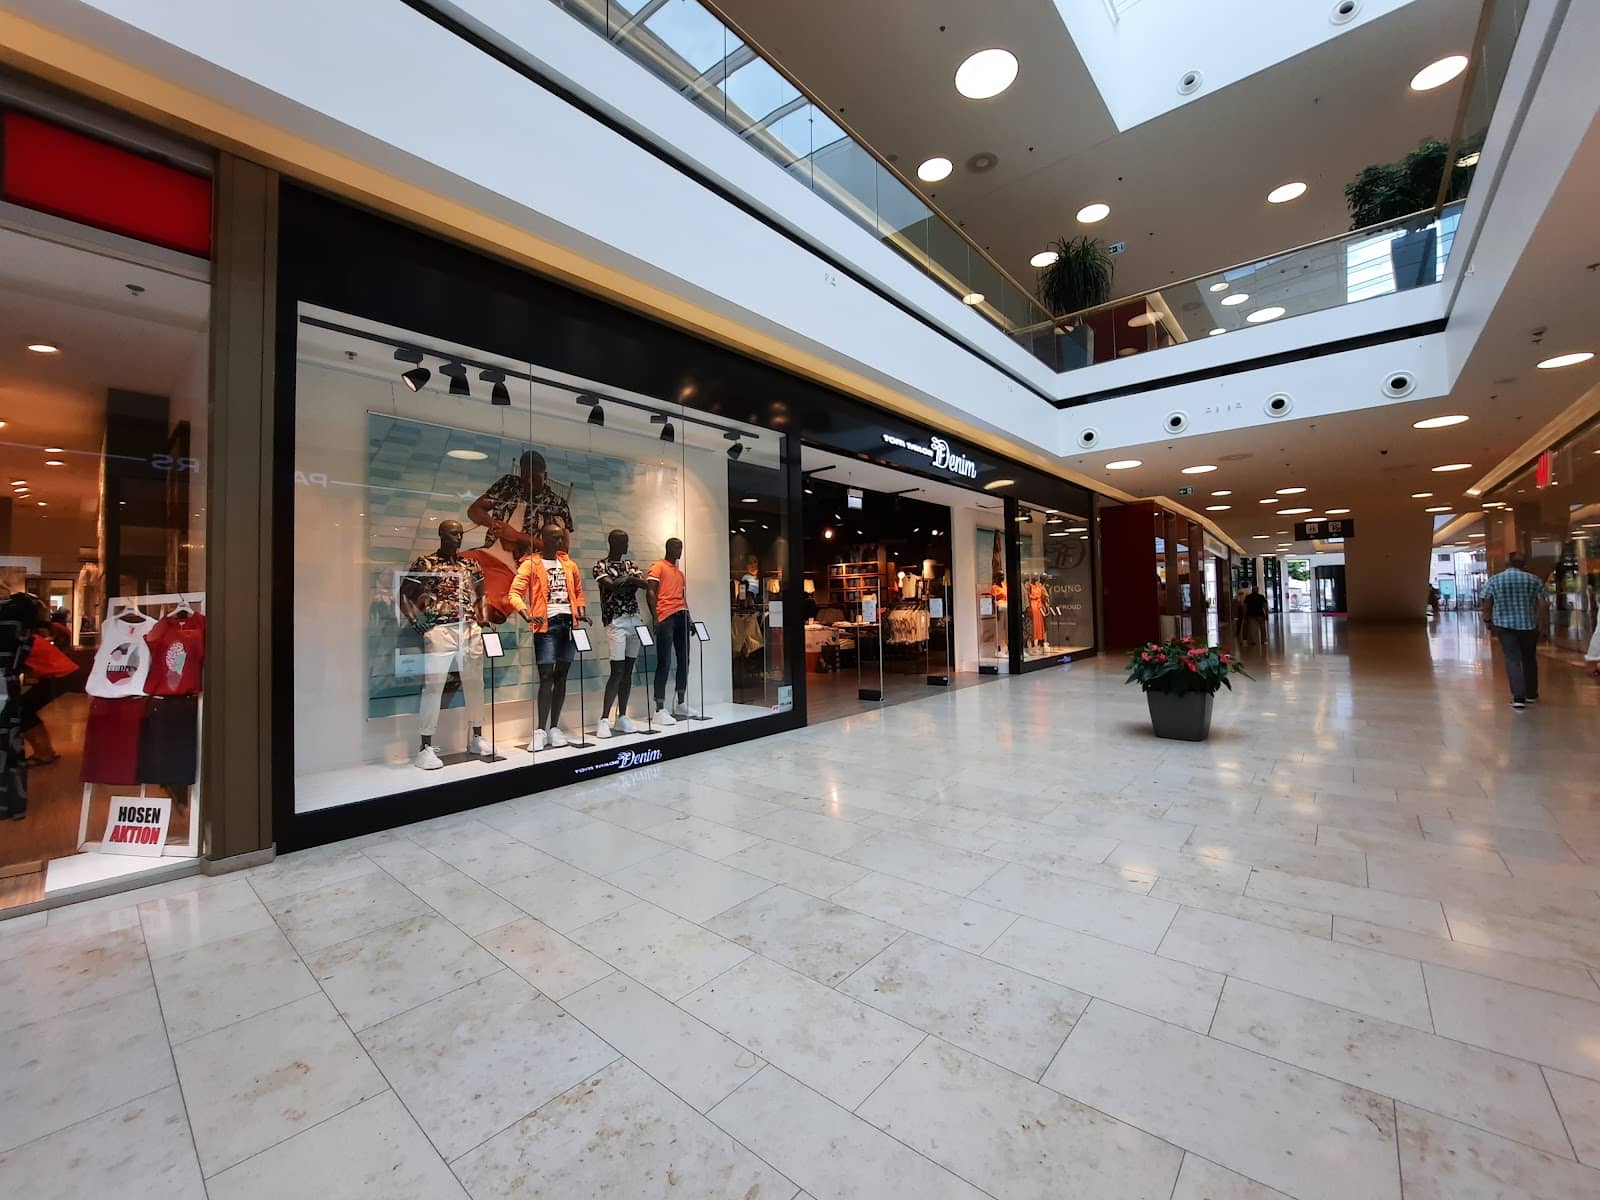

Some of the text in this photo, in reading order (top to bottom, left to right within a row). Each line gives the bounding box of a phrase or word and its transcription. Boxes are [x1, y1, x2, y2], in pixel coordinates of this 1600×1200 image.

[883, 434, 905, 447] TOM
[930, 436, 977, 479] Denim
[1047, 584, 1082, 593] YOUNG
[574, 766, 594, 774] TOM
[617, 749, 662, 769] Denim
[118, 806, 161, 824] HOSEN
[109, 825, 161, 844] AKTION
